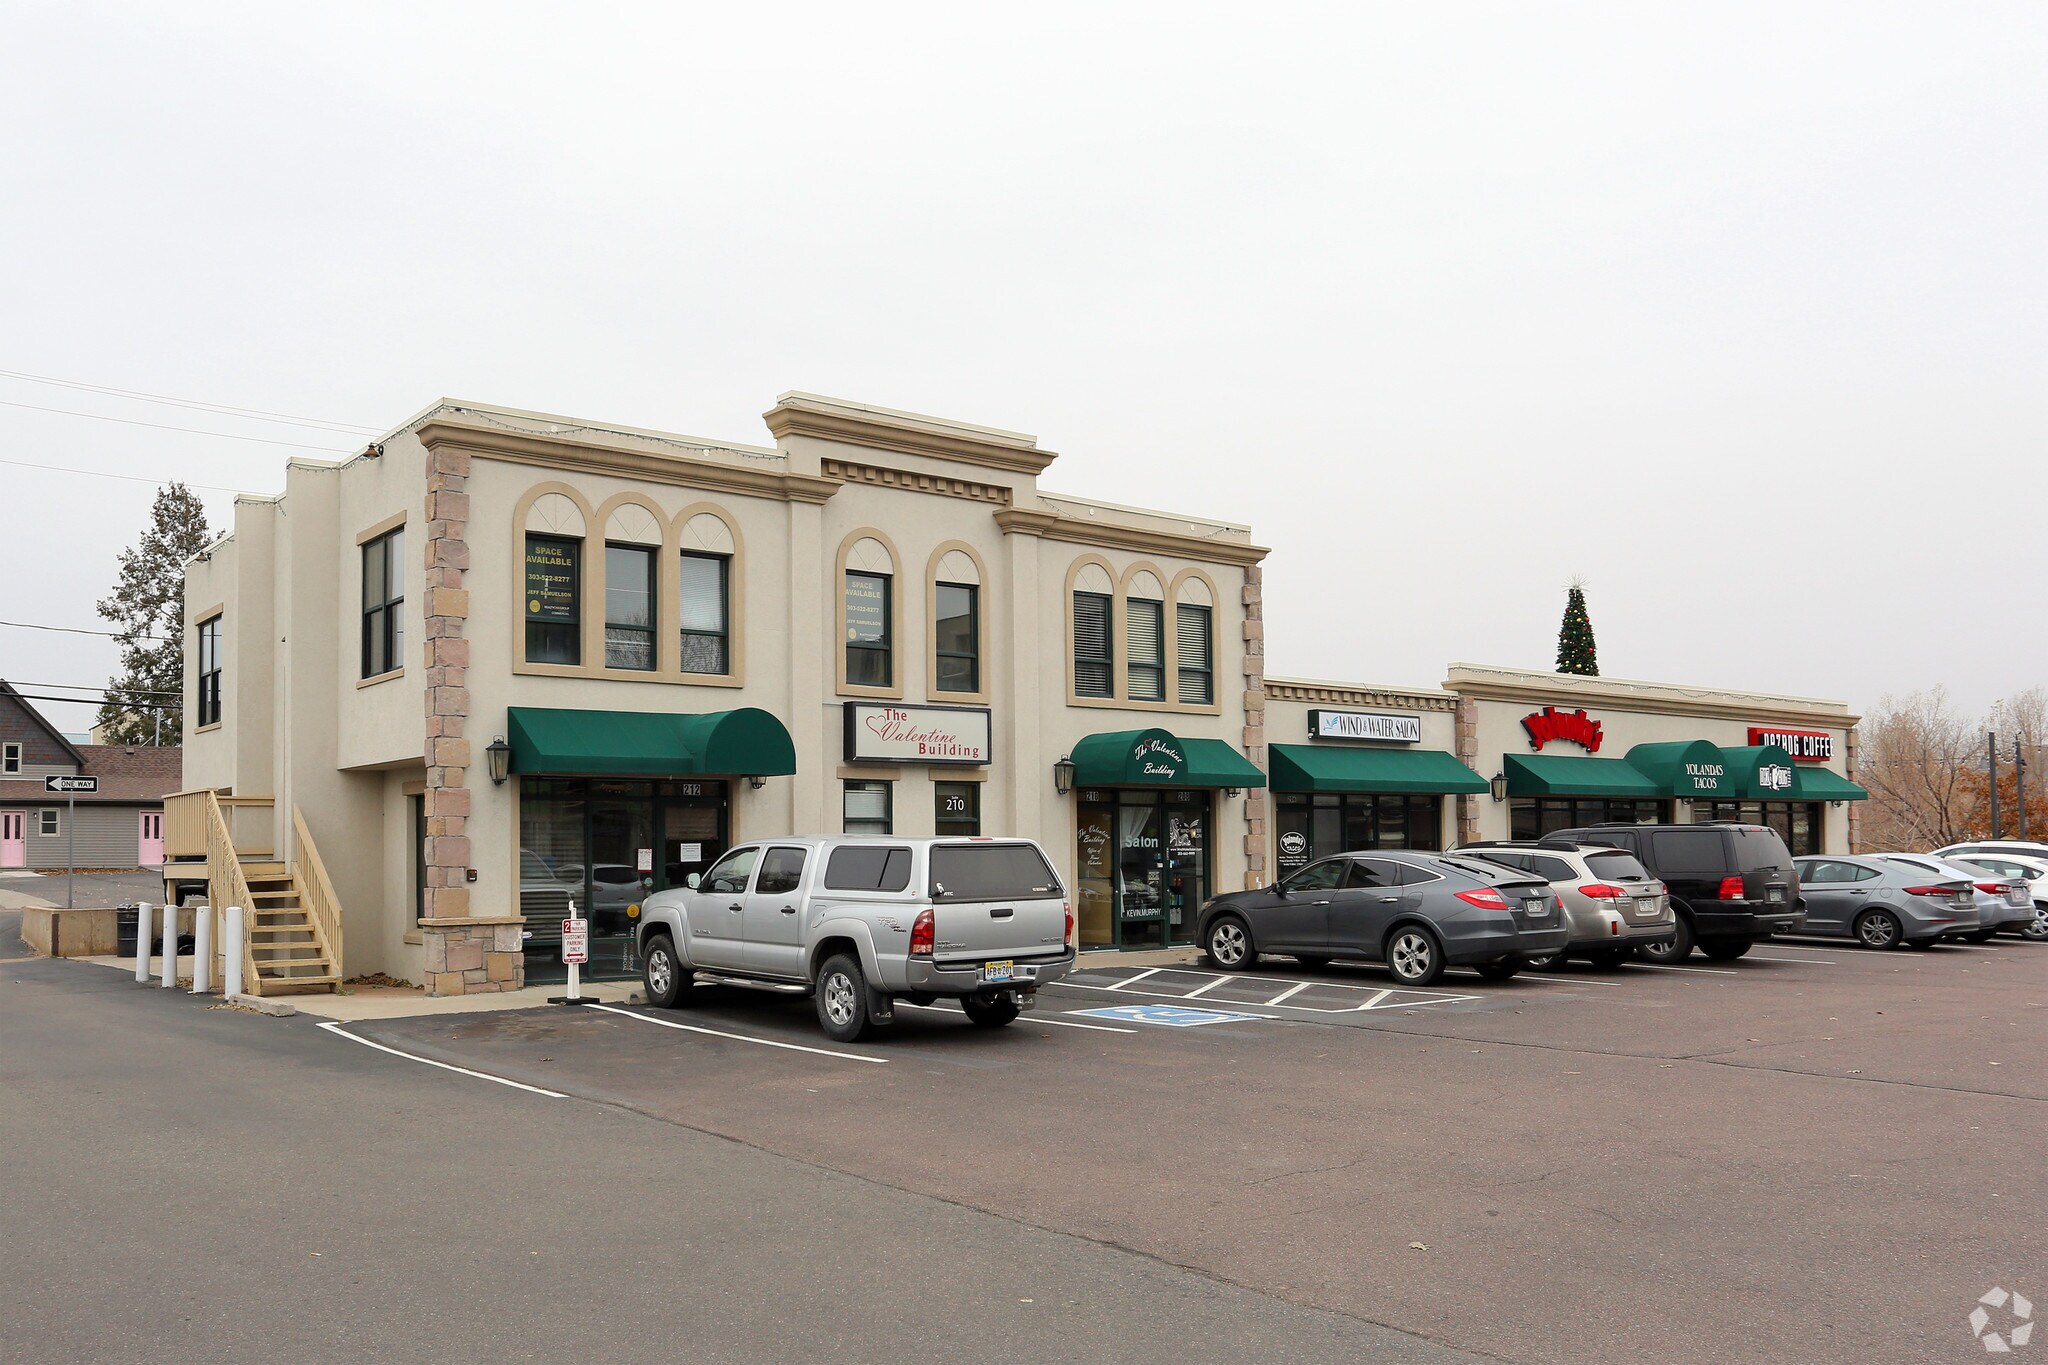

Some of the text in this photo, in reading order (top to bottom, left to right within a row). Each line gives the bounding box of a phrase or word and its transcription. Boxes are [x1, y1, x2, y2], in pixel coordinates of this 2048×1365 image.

[535, 546, 562, 556] SPACE
[526, 555, 572, 566] AVAILABLE
[528, 574, 570, 582] 303-522-8277
[851, 581, 873, 589] SPACE
[846, 589, 881, 598] AVAILABLE
[884, 708, 908, 721] The
[881, 721, 957, 743] Valentine
[1339, 715, 1362, 735] WIND
[1367, 717, 1394, 737] WATER
[1395, 720, 1417, 738] SALON
[918, 743, 979, 758] Building
[1134, 739, 1183, 763] The Valentine
[1803, 736, 1835, 756] COFFEE
[1143, 762, 1176, 779] Building
[1693, 777, 1717, 789] TACOS
[684, 784, 700, 796] 212
[946, 799, 965, 811] 210
[1083, 834, 1106, 845] Building
[1125, 835, 1159, 848] Salon
[564, 921, 570, 932] 2
